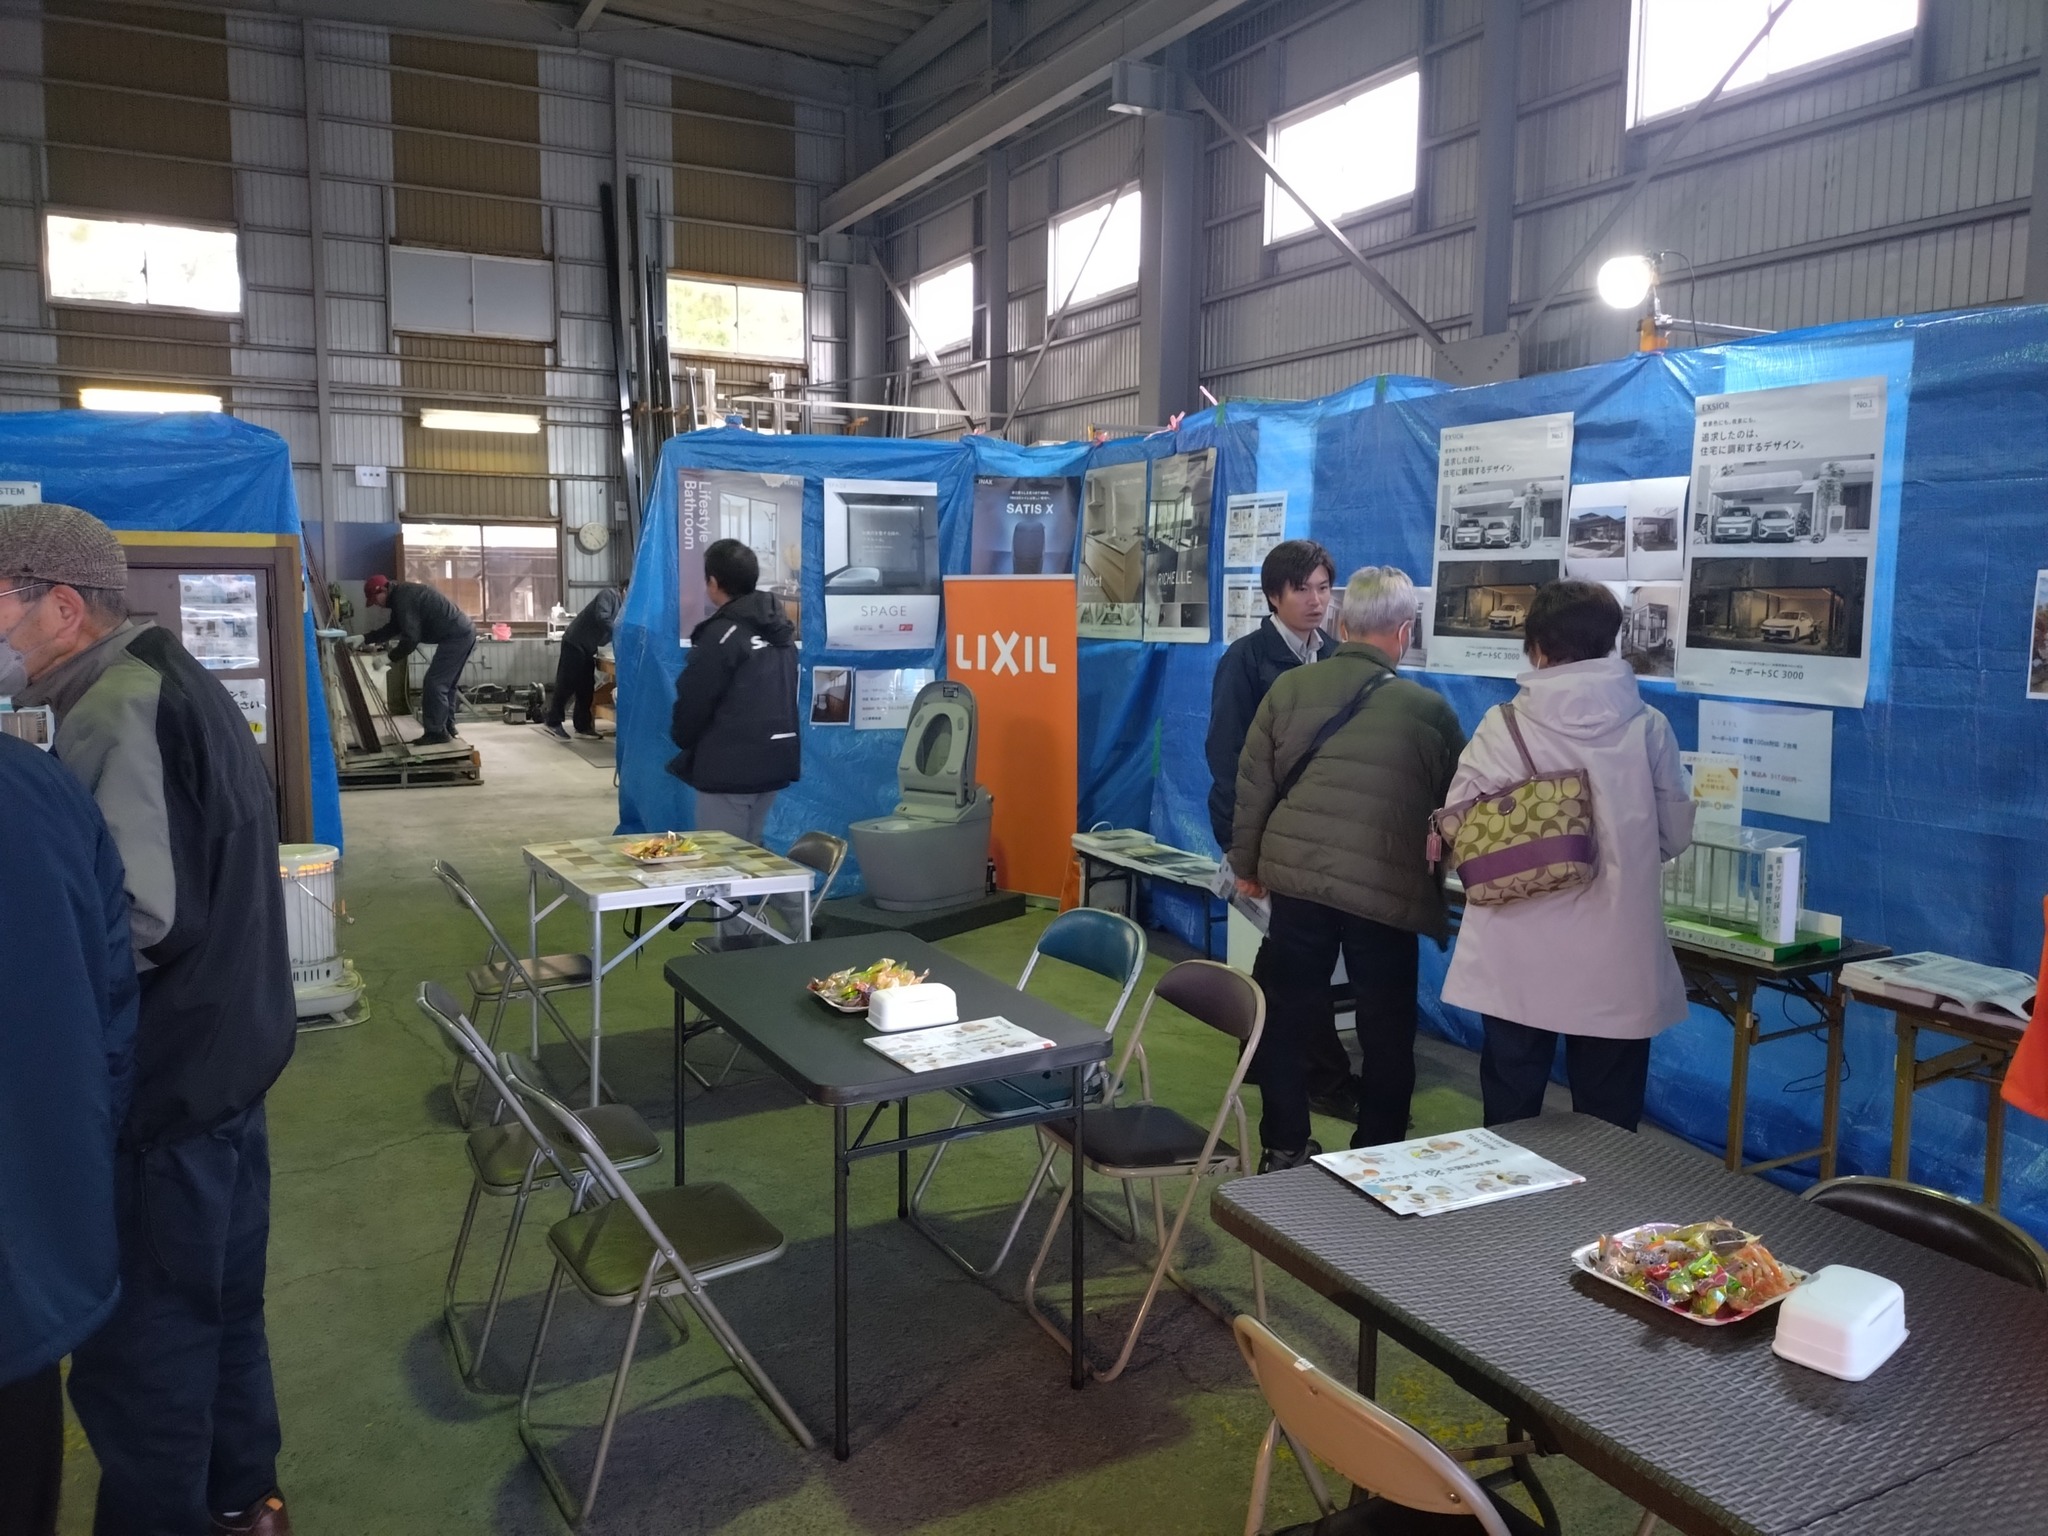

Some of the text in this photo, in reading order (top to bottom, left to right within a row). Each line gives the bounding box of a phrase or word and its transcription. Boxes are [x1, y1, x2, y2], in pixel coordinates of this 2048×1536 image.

[1702, 402, 1730, 413] EXSIOR
[1856, 400, 1873, 409] No.1
[1701, 429, 1759, 443] 追求したのは、
[1700, 440, 1804, 457] 住宅に調和するデザイン。
[684, 480, 697, 550] Bathroom
[696, 481, 712, 543] Lifestyle
[1006, 503, 1054, 515] SATIS X
[1082, 575, 1103, 587] Noct
[1157, 570, 1193, 586] RICHELLE
[861, 605, 907, 617] SPAGE
[956, 630, 1057, 677] LIXIL
[1729, 666, 1804, 680] カーポートSC 3000
